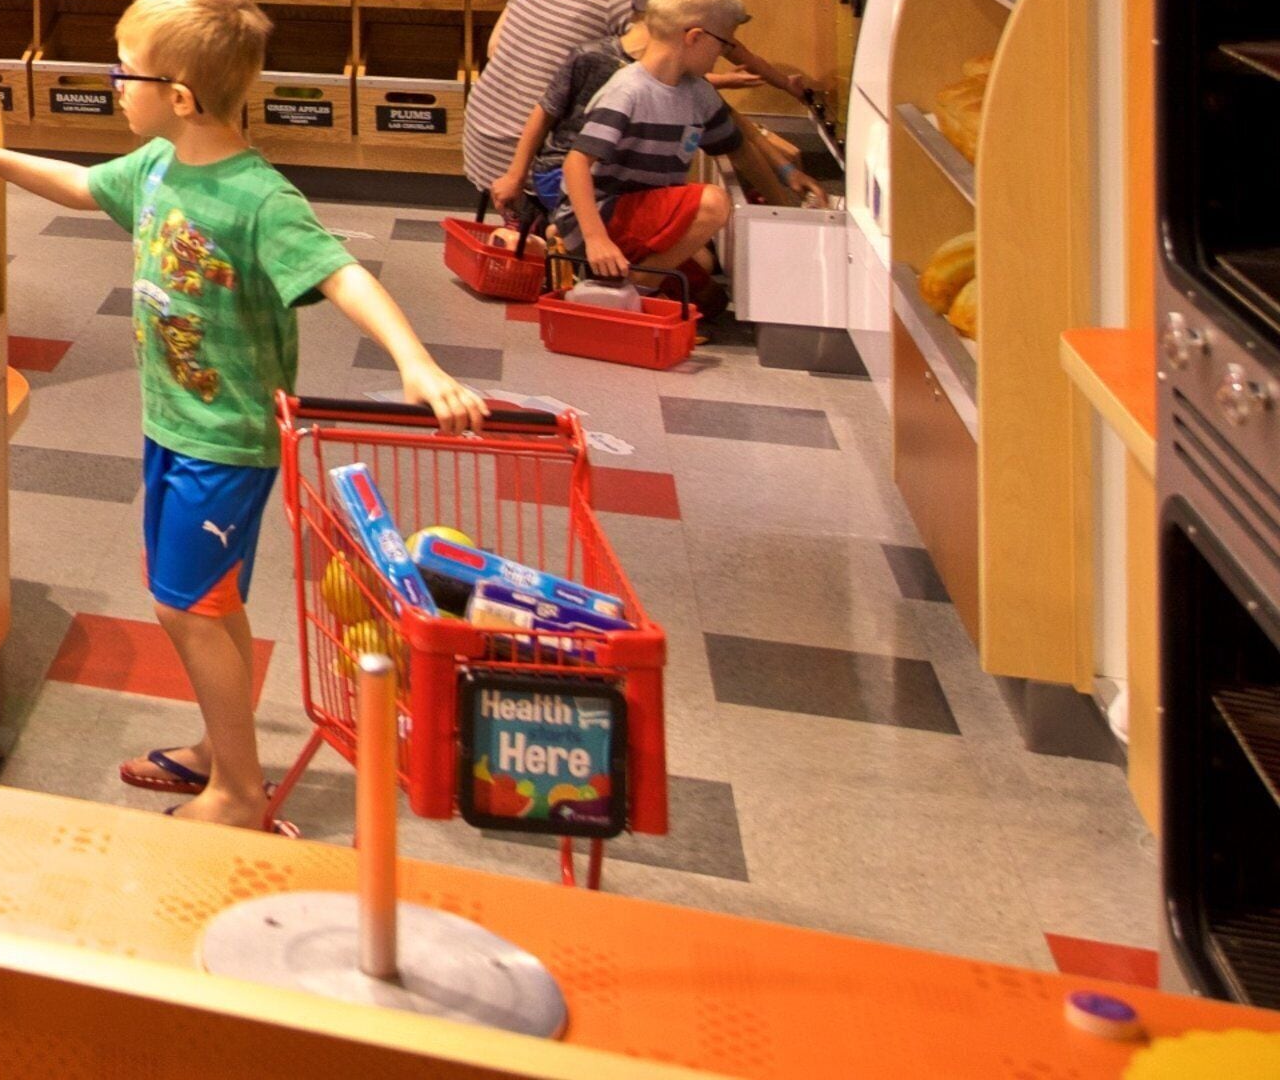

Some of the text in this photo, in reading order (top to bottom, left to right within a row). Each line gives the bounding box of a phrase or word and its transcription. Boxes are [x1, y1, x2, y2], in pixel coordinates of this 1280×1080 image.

[56, 92, 107, 104] BANANAS
[267, 104, 331, 114] GREEN APPLES
[390, 109, 432, 120] PLUMS
[481, 689, 573, 726] Health
[499, 731, 590, 779] Here
